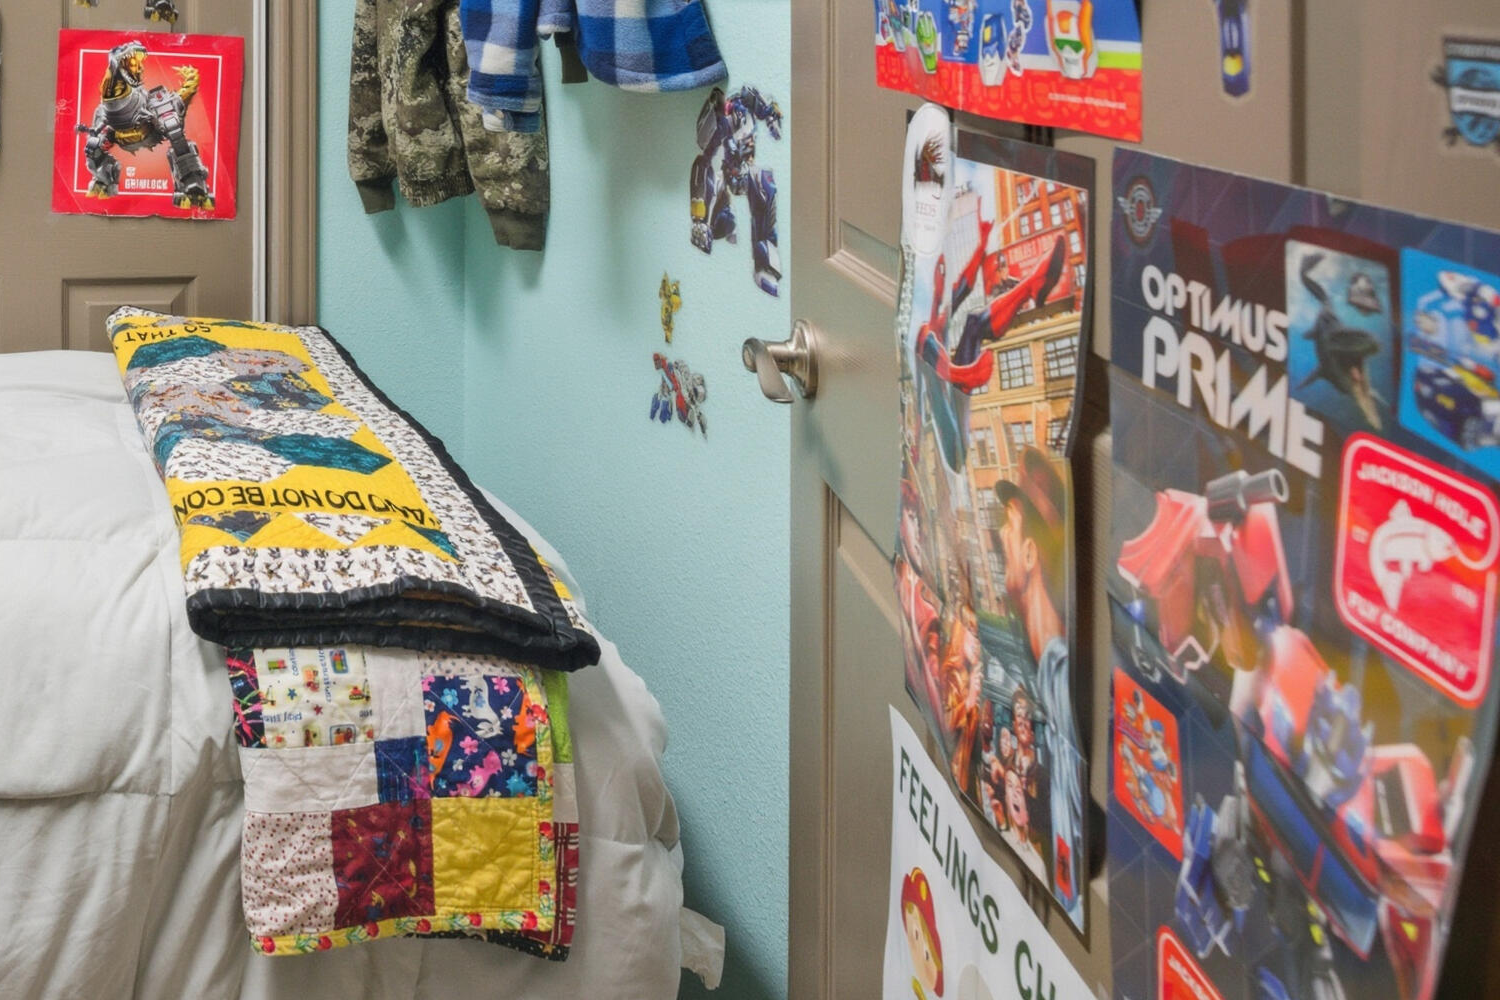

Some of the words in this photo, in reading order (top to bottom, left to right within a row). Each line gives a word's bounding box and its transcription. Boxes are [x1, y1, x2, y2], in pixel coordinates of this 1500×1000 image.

[124, 178, 169, 190] GRIMLOCK
[1141, 264, 1288, 363] OPTIMUS
[123, 329, 178, 343] THAT
[183, 324, 212, 334] SO
[1142, 315, 1325, 480] PRIME
[230, 485, 266, 507] BE
[269, 488, 325, 509] NOT
[324, 489, 367, 512] DO
[1356, 462, 1434, 505] JACKSON
[1434, 493, 1487, 541] HOLE
[899, 744, 1001, 955] FEELINGS
